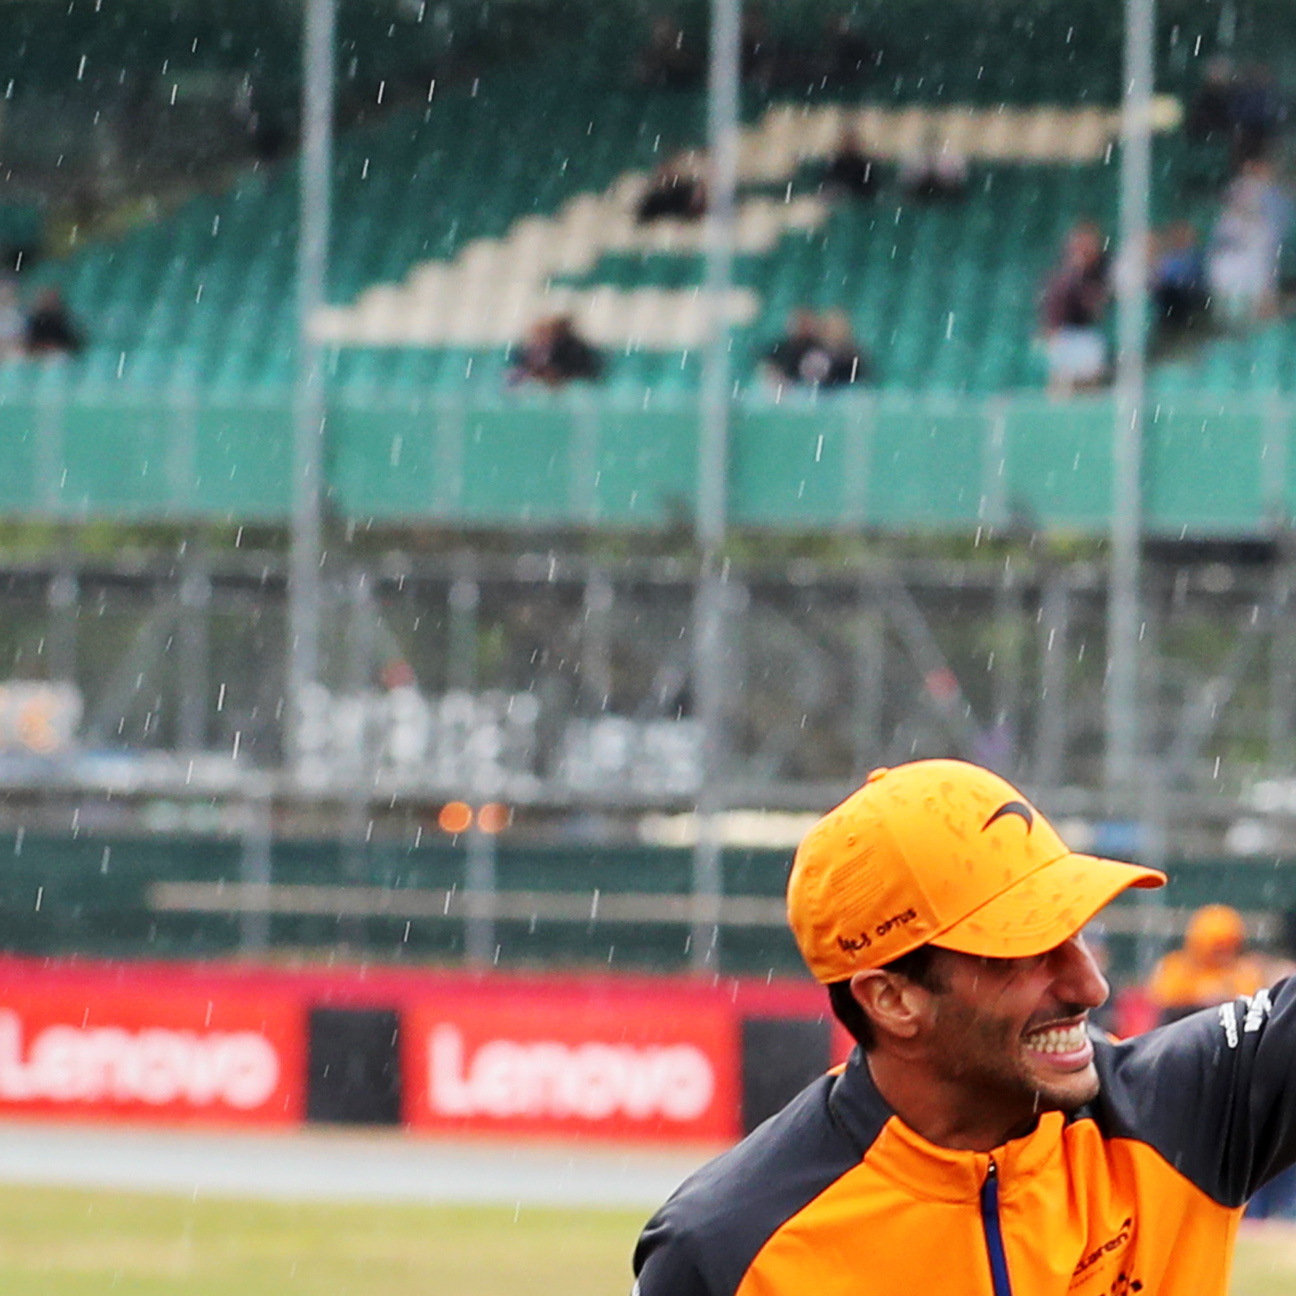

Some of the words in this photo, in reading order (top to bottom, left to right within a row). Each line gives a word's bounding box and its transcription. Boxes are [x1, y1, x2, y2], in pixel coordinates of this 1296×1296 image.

[876, 906, 917, 936] OPTUS
[0, 1006, 279, 1110] Lenovo
[427, 1021, 715, 1122] Lenovo
